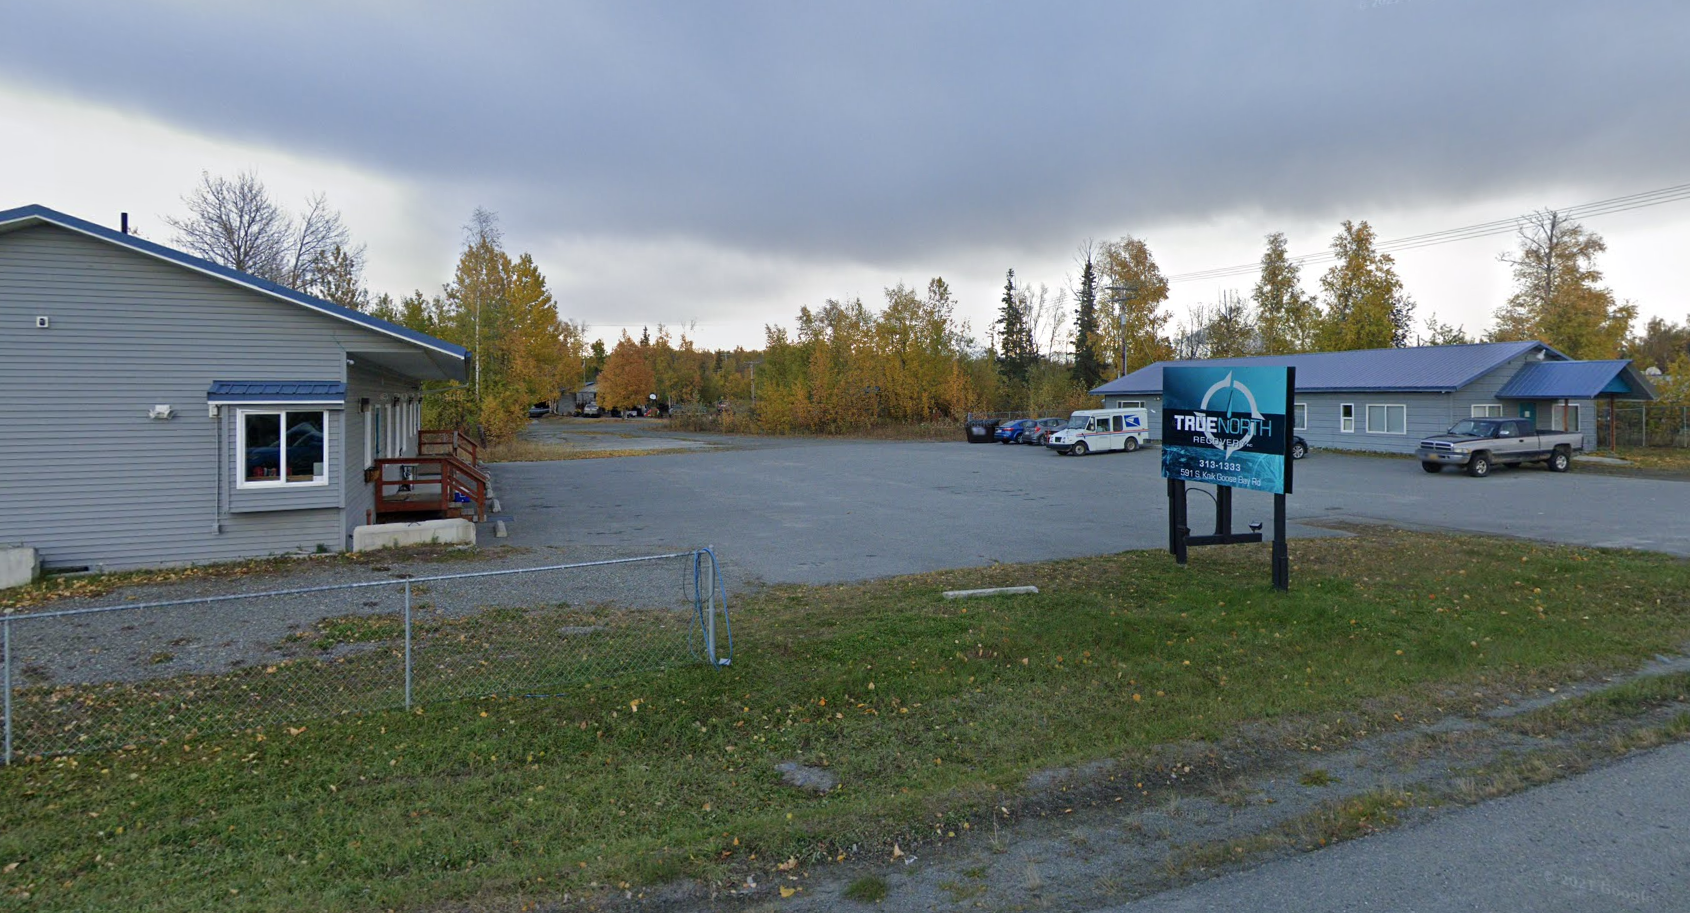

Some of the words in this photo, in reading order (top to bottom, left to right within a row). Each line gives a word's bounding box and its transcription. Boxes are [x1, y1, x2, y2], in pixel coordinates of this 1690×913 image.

[1192, 435, 1246, 448] RECOVERY
[1199, 459, 1241, 472] 313-1333
[1180, 468, 1193, 477] 591
[1202, 471, 1217, 481] Knik
[1216, 473, 1237, 483] Goose
[1238, 475, 1250, 486] Bay
[1251, 477, 1261, 487] Rd
